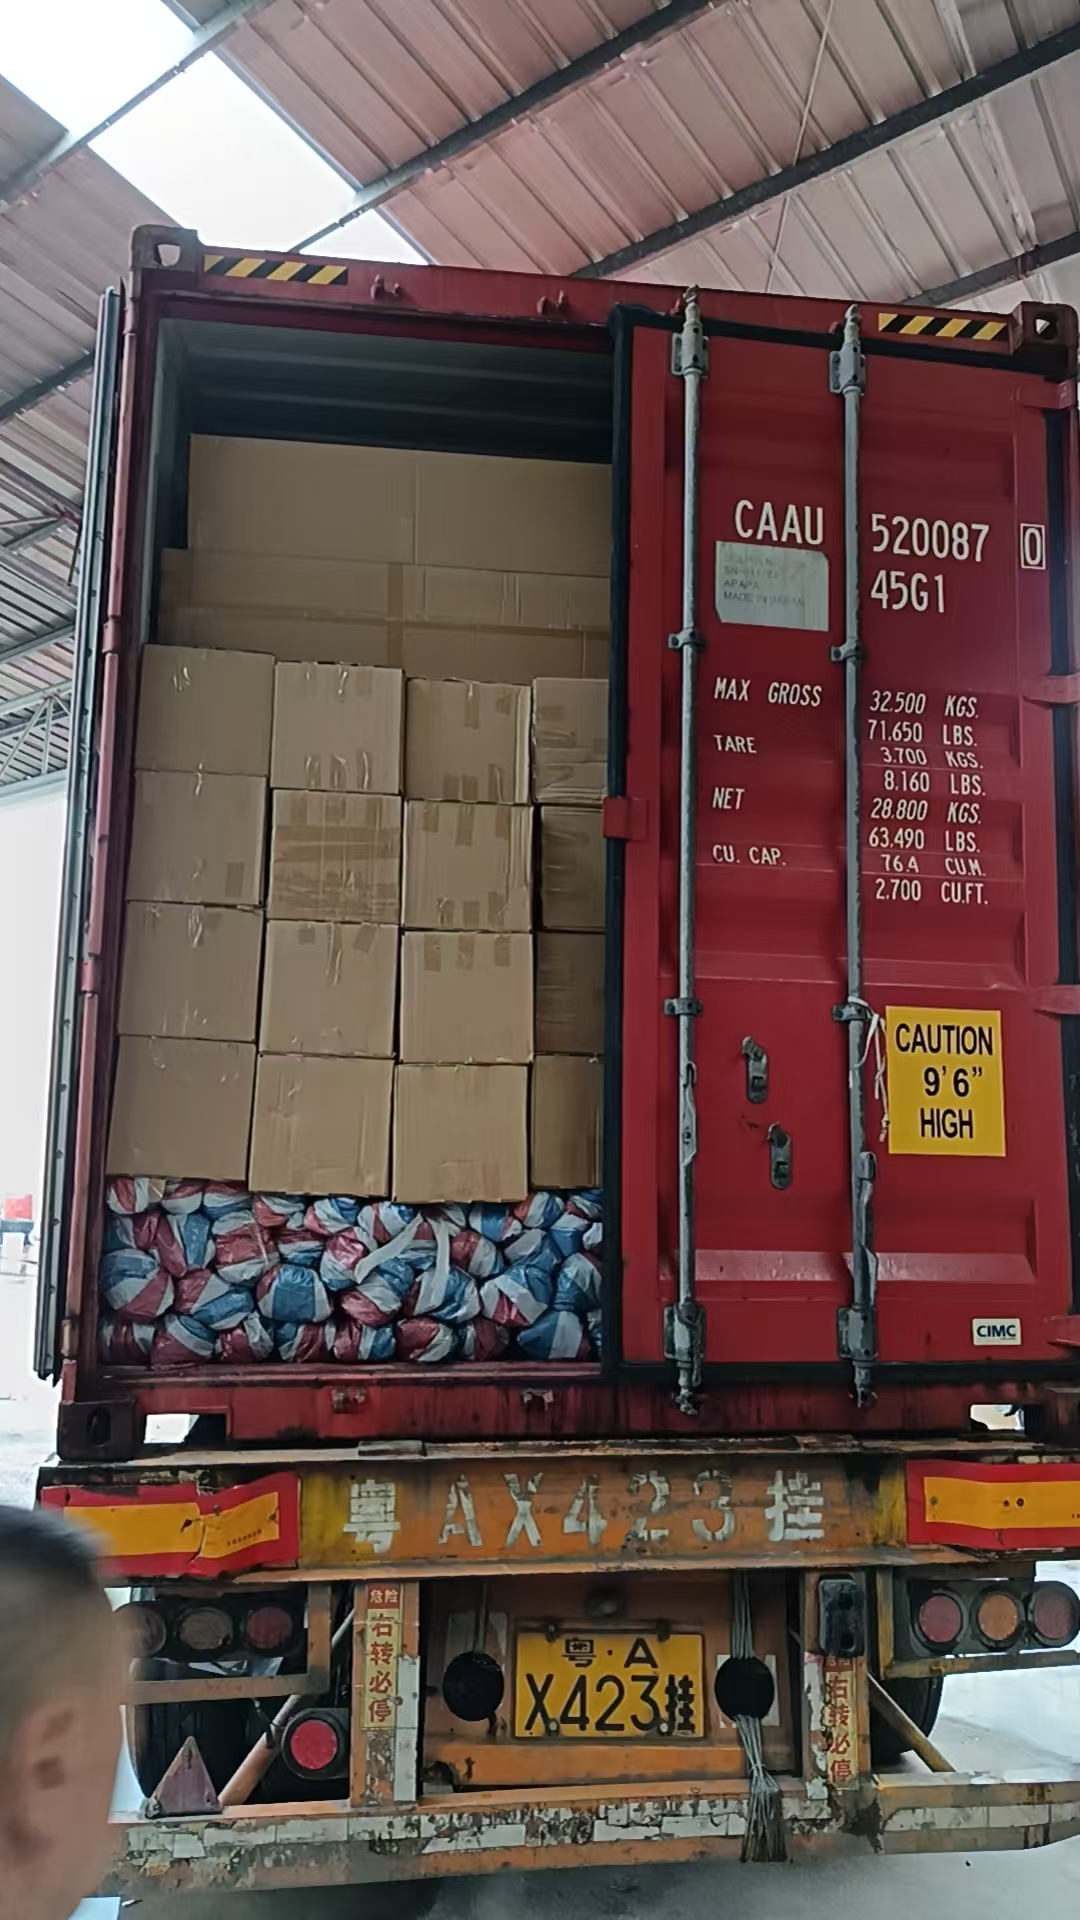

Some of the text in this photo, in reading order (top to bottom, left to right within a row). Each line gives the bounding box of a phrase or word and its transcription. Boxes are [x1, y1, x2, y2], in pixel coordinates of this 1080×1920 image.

[735, 500, 1042, 566] CAAU 520087 0
[870, 569, 945, 613] 45G1
[713, 677, 751, 702] MAX
[767, 681, 823, 707] GROSS
[944, 695, 979, 719] KGS.
[714, 734, 757, 754] TARE
[945, 751, 984, 769] KGS.
[942, 724, 978, 747] LBS.
[950, 773, 986, 796] LBS.
[712, 787, 745, 810] NET
[947, 802, 981, 825] KGS.
[712, 844, 741, 864] CU.
[748, 846, 786, 866] CAP.
[945, 830, 981, 853] LBS.
[895, 1023, 993, 1056] CAUTION
[920, 1107, 974, 1139] HIGH
[976, 1324, 1017, 1338] CIMC
[370, 1589, 399, 1604] 危险
[368, 1613, 394, 1723] 右转必停
[524, 1673, 695, 1736] X423挂
[828, 1676, 852, 1783] 右转必停
